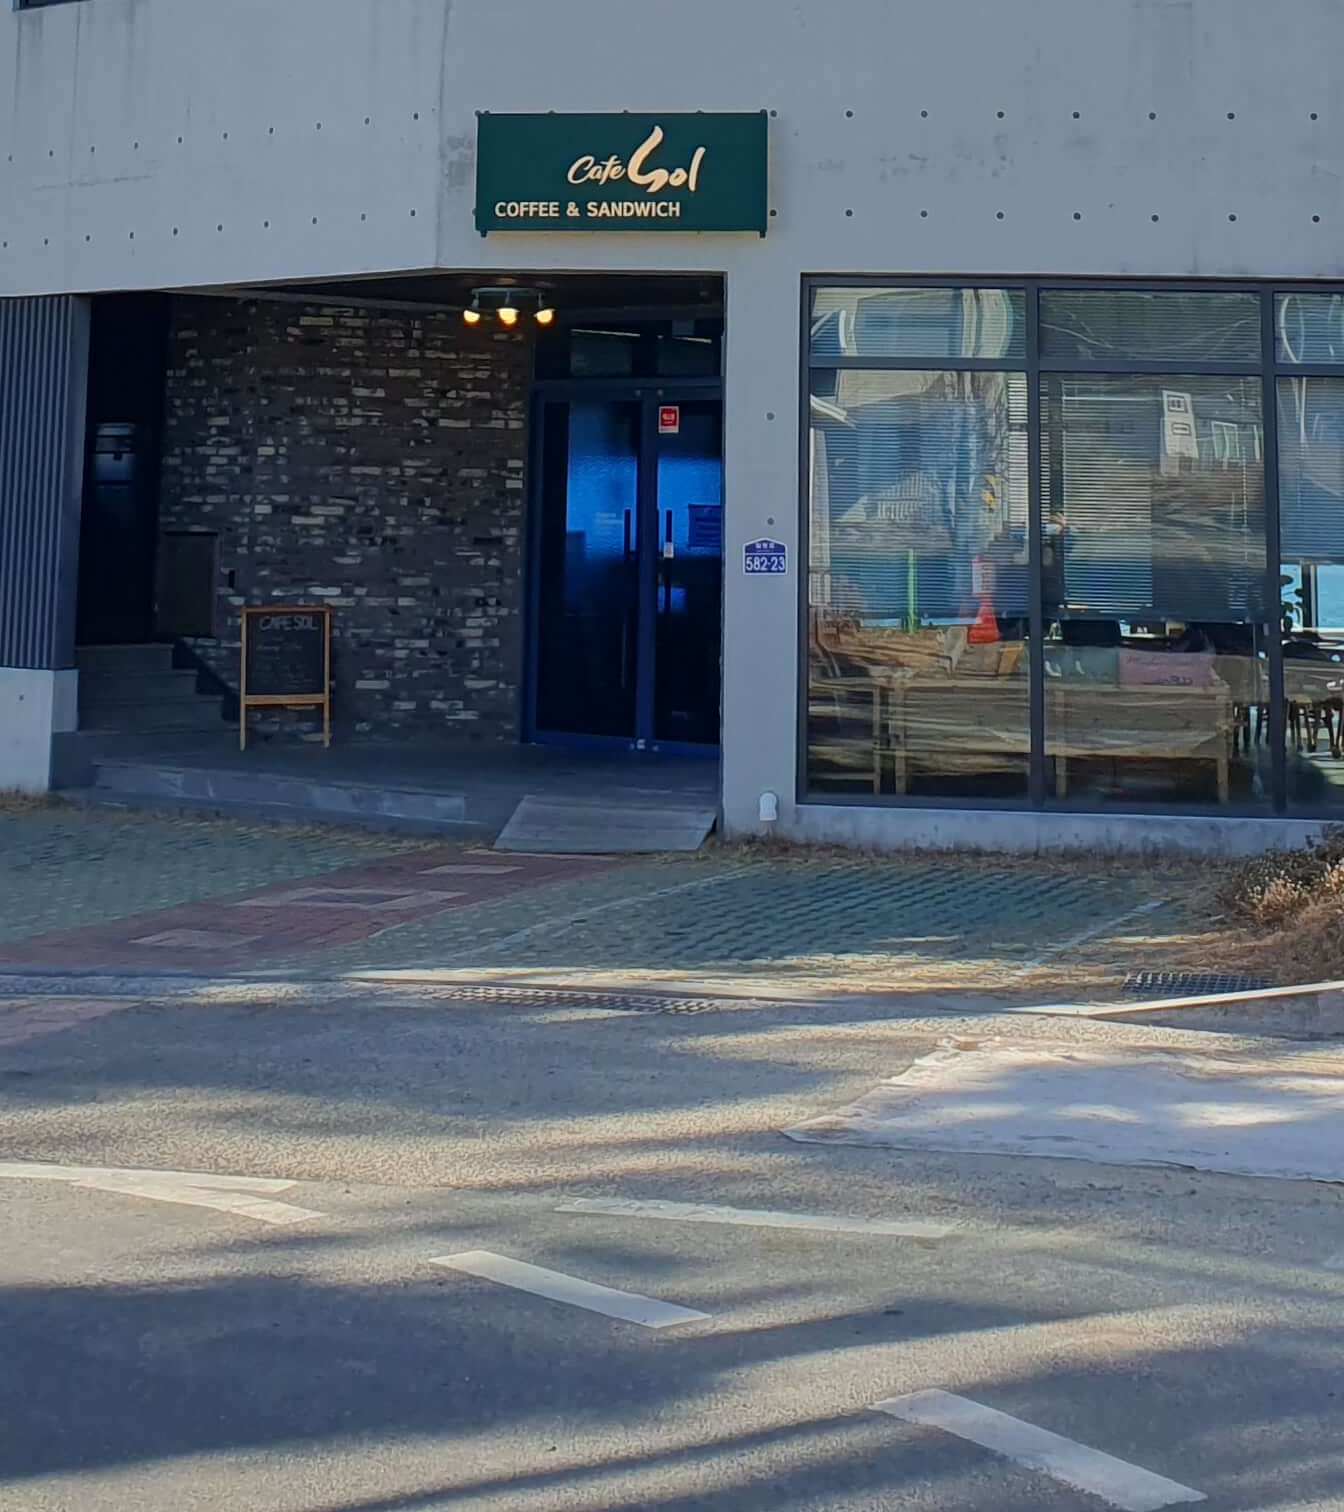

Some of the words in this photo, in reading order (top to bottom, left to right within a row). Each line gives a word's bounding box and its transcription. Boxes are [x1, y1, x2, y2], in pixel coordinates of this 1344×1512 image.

[567, 155, 626, 186] Cafe
[628, 125, 706, 193] Sol
[495, 201, 559, 218] COFFEE
[566, 201, 580, 217] &
[587, 201, 681, 218] SANDWICH
[746, 556, 785, 571] 582-23
